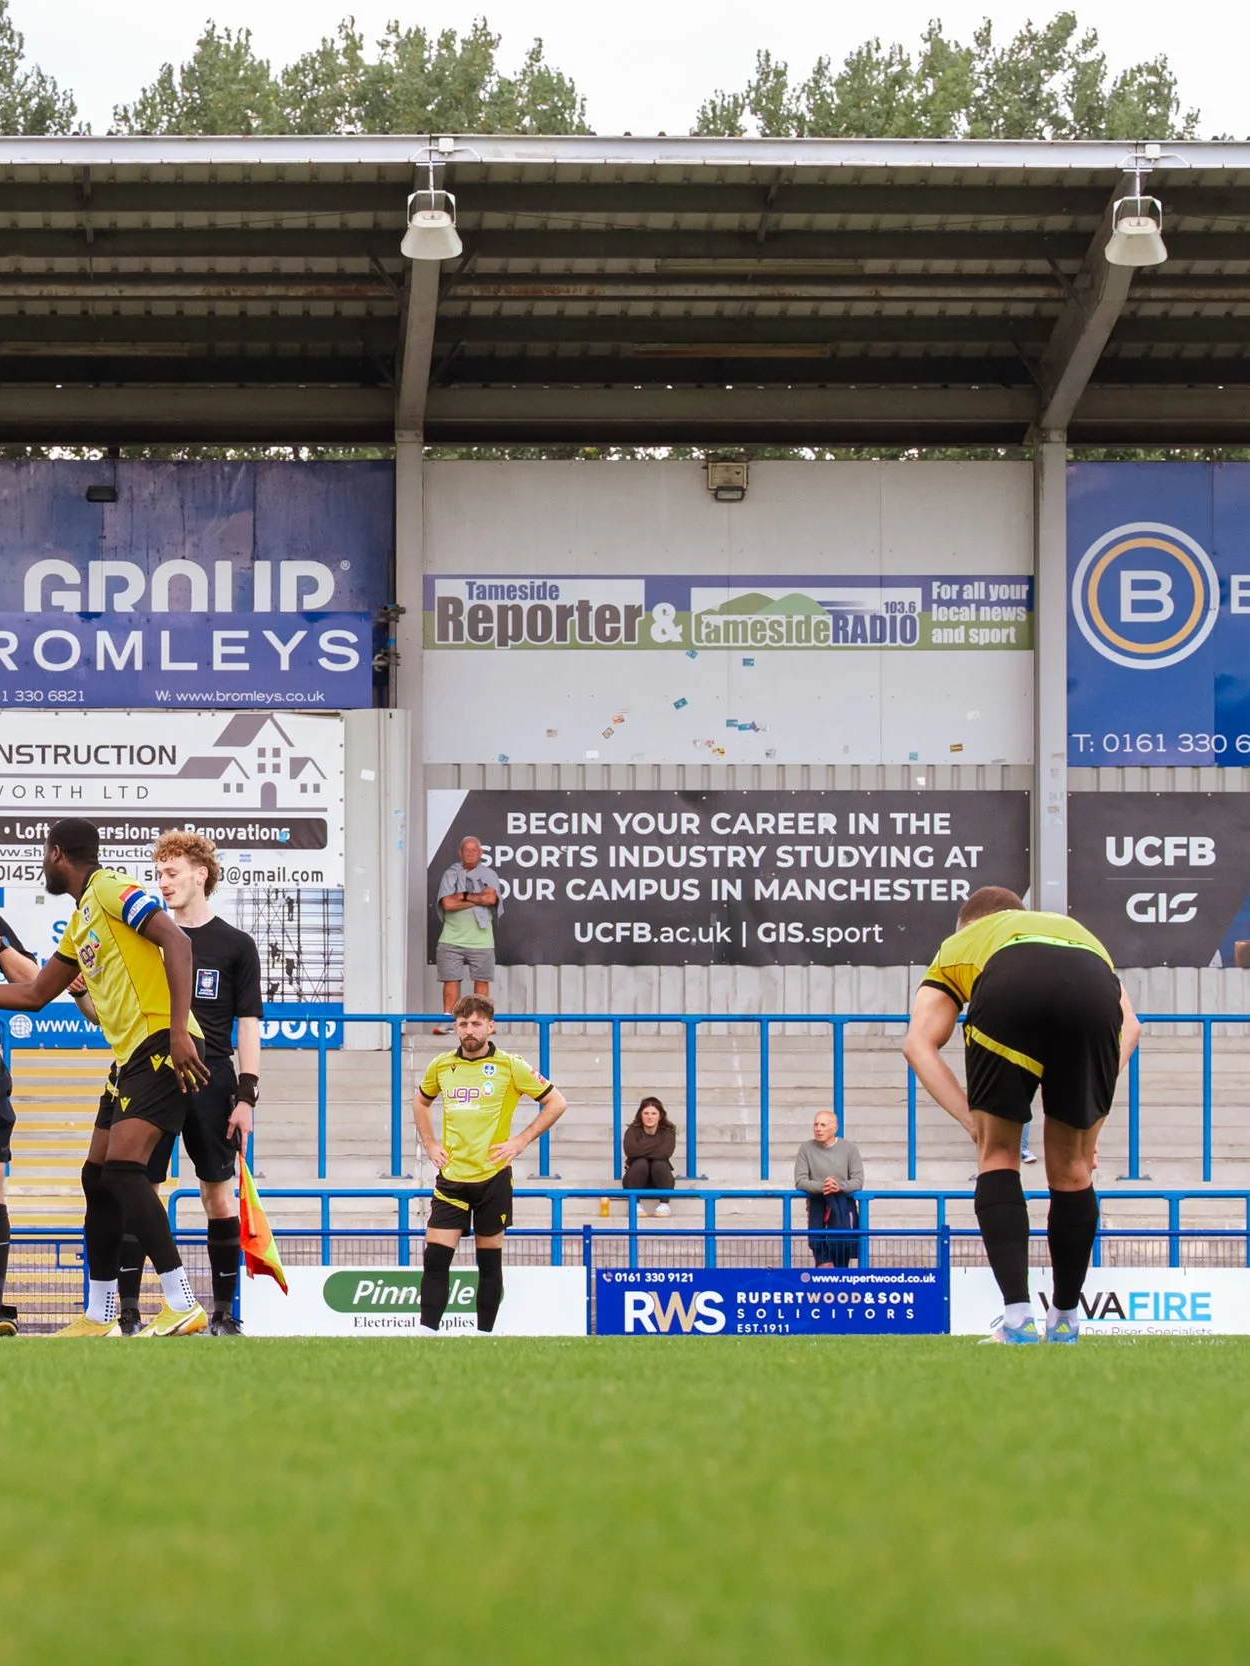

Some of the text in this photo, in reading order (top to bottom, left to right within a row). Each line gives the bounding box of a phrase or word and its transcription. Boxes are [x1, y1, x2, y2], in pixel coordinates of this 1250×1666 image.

[465, 581, 559, 600] Tameside
[932, 581, 1029, 603] For all your
[1120, 570, 1175, 622] B
[883, 601, 916, 614] 103.6
[932, 604, 1027, 622] local news
[437, 597, 683, 647] Reporter &
[932, 626, 1016, 648] and sport
[14, 690, 44, 702] 330
[48, 690, 84, 702] 6821
[155, 689, 325, 703] W: www.bromleys.co.uk
[1072, 734, 1095, 753] T:
[1103, 734, 1166, 753] 0161
[1178, 734, 1228, 753] 330
[103, 783, 150, 800] LTD
[507, 812, 951, 834] BEGIN YOUR CAREER IN THE
[481, 845, 983, 868] SPORTS INDUSTRY STUDYING AT
[1106, 836, 1216, 866] UCFB
[565, 878, 701, 901] CAMPUS
[711, 878, 742, 901] IN
[754, 878, 971, 901] MANCHESTER
[1126, 893, 1198, 923] GIS
[574, 921, 883, 948] UCFB.ac.uk GIS.sport
[447, 1088, 480, 1103] ugp
[615, 1273, 936, 1285] 0161 330 9121 www.rupertwood.co.uk
[352, 1279, 475, 1305] Pinnle
[624, 1290, 726, 1333] RWS
[736, 1308, 915, 1319] SOLICITORS
[354, 1316, 416, 1328] Electrical
[736, 1323, 791, 1333] EST.1911
